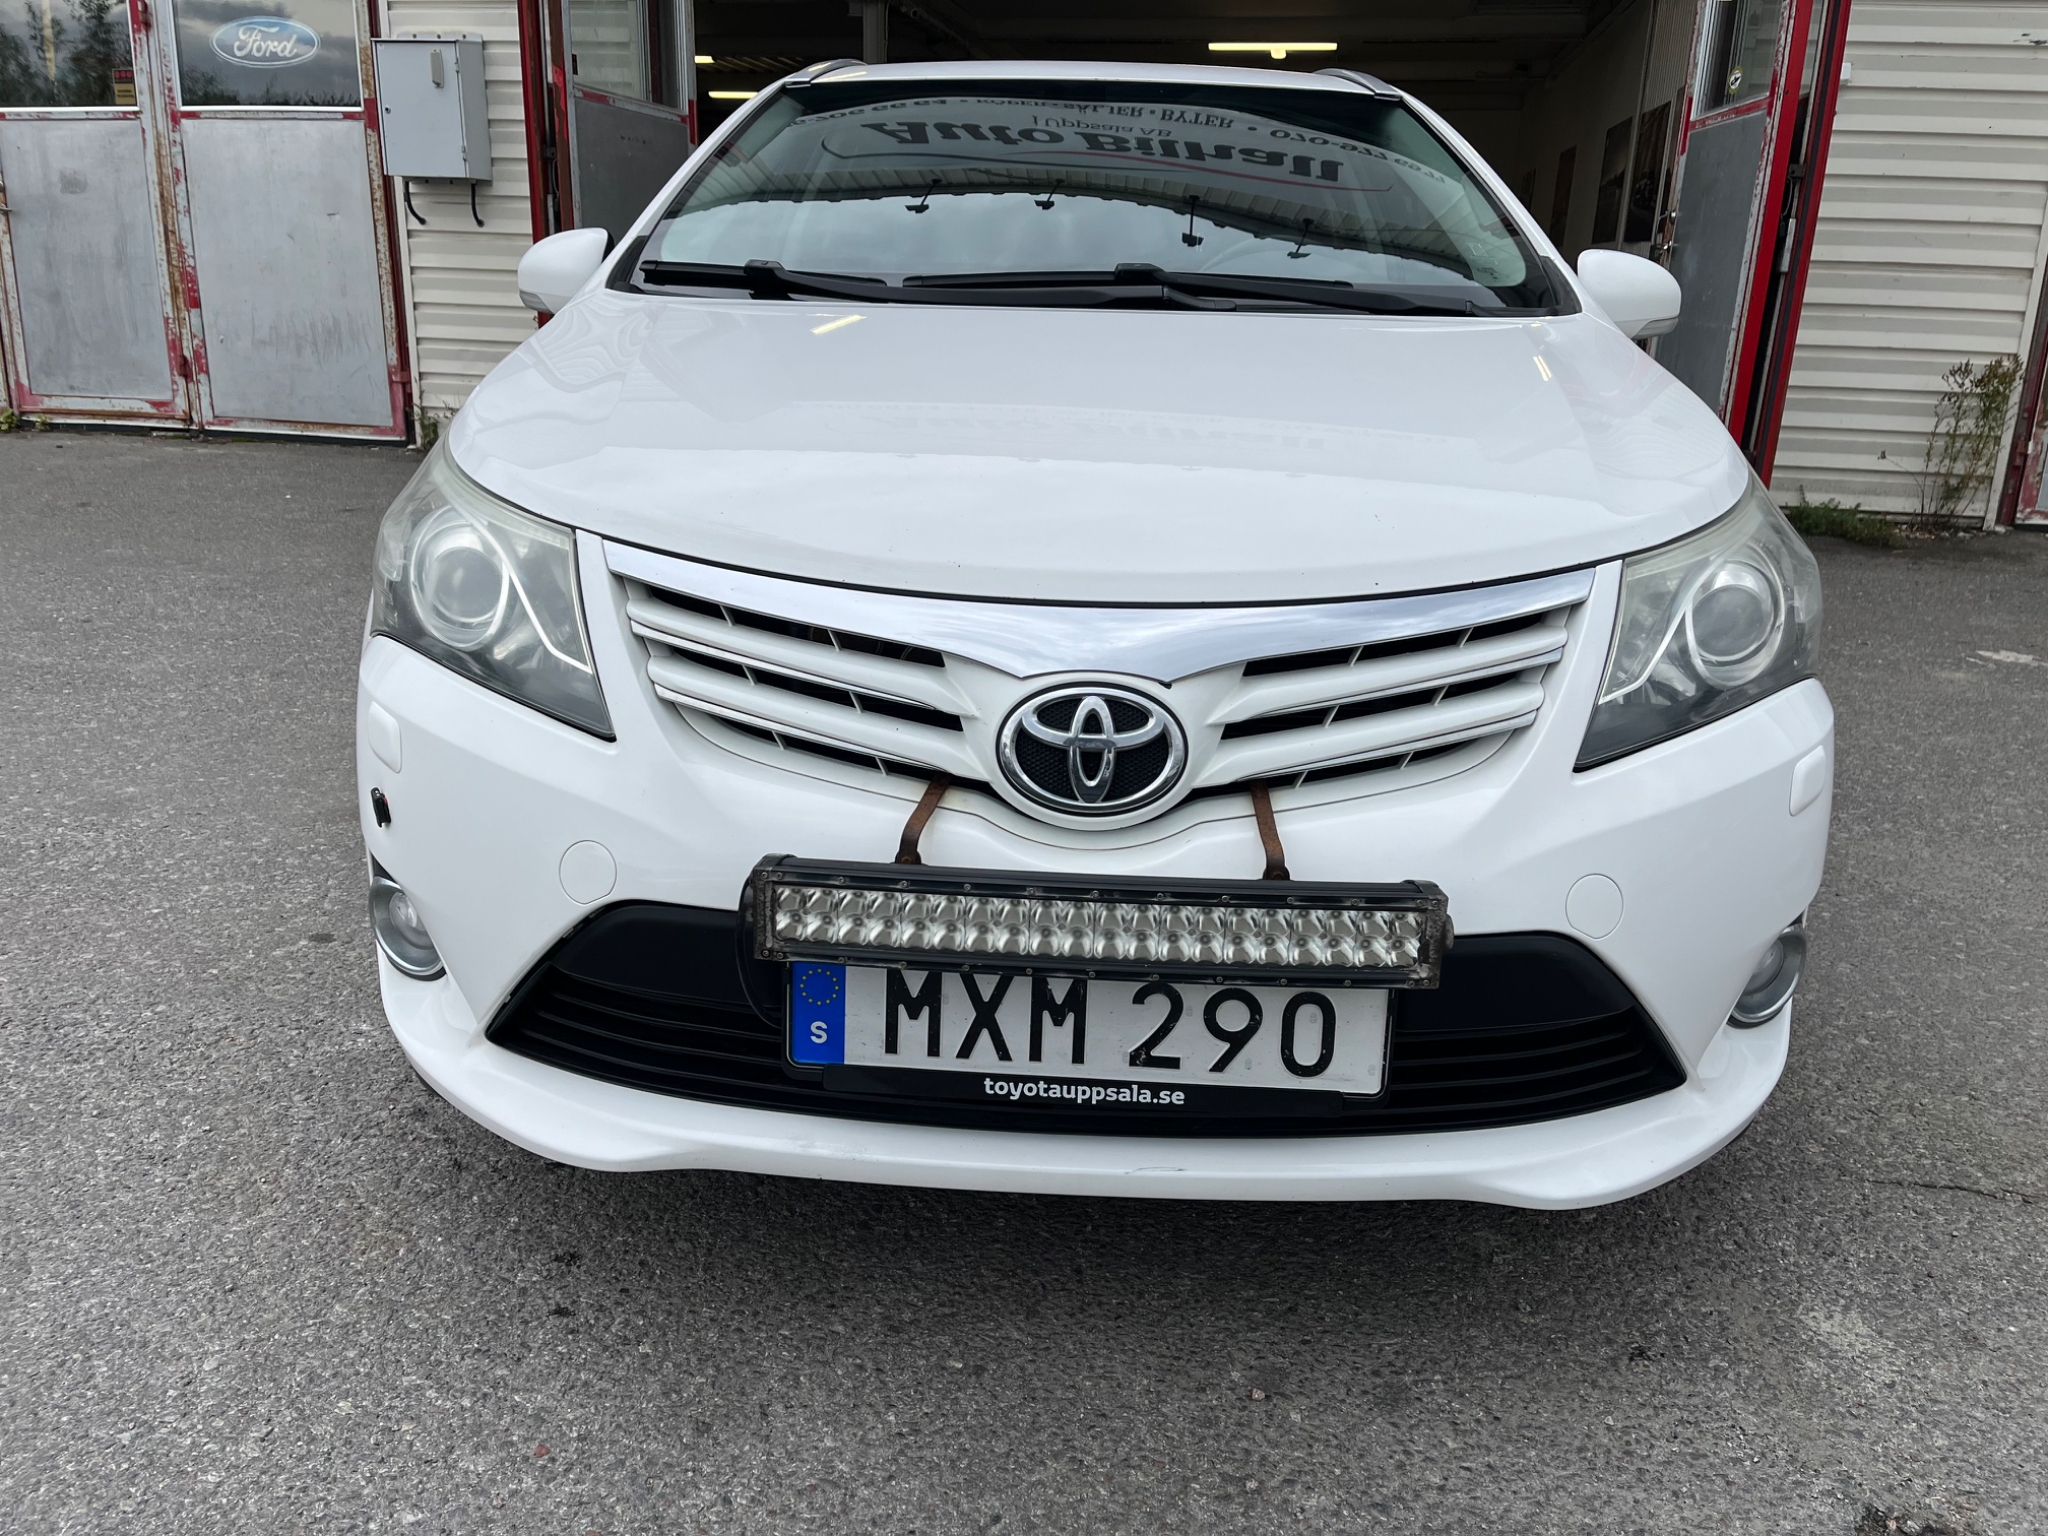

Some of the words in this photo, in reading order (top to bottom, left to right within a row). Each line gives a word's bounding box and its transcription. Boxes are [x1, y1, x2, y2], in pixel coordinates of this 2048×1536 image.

[233, 25, 297, 57] Ford
[810, 1021, 828, 1043] S
[885, 969, 1088, 1064] MXM
[1128, 982, 1337, 1077] 290
[984, 1077, 1185, 1105] toyotauppsala.se
